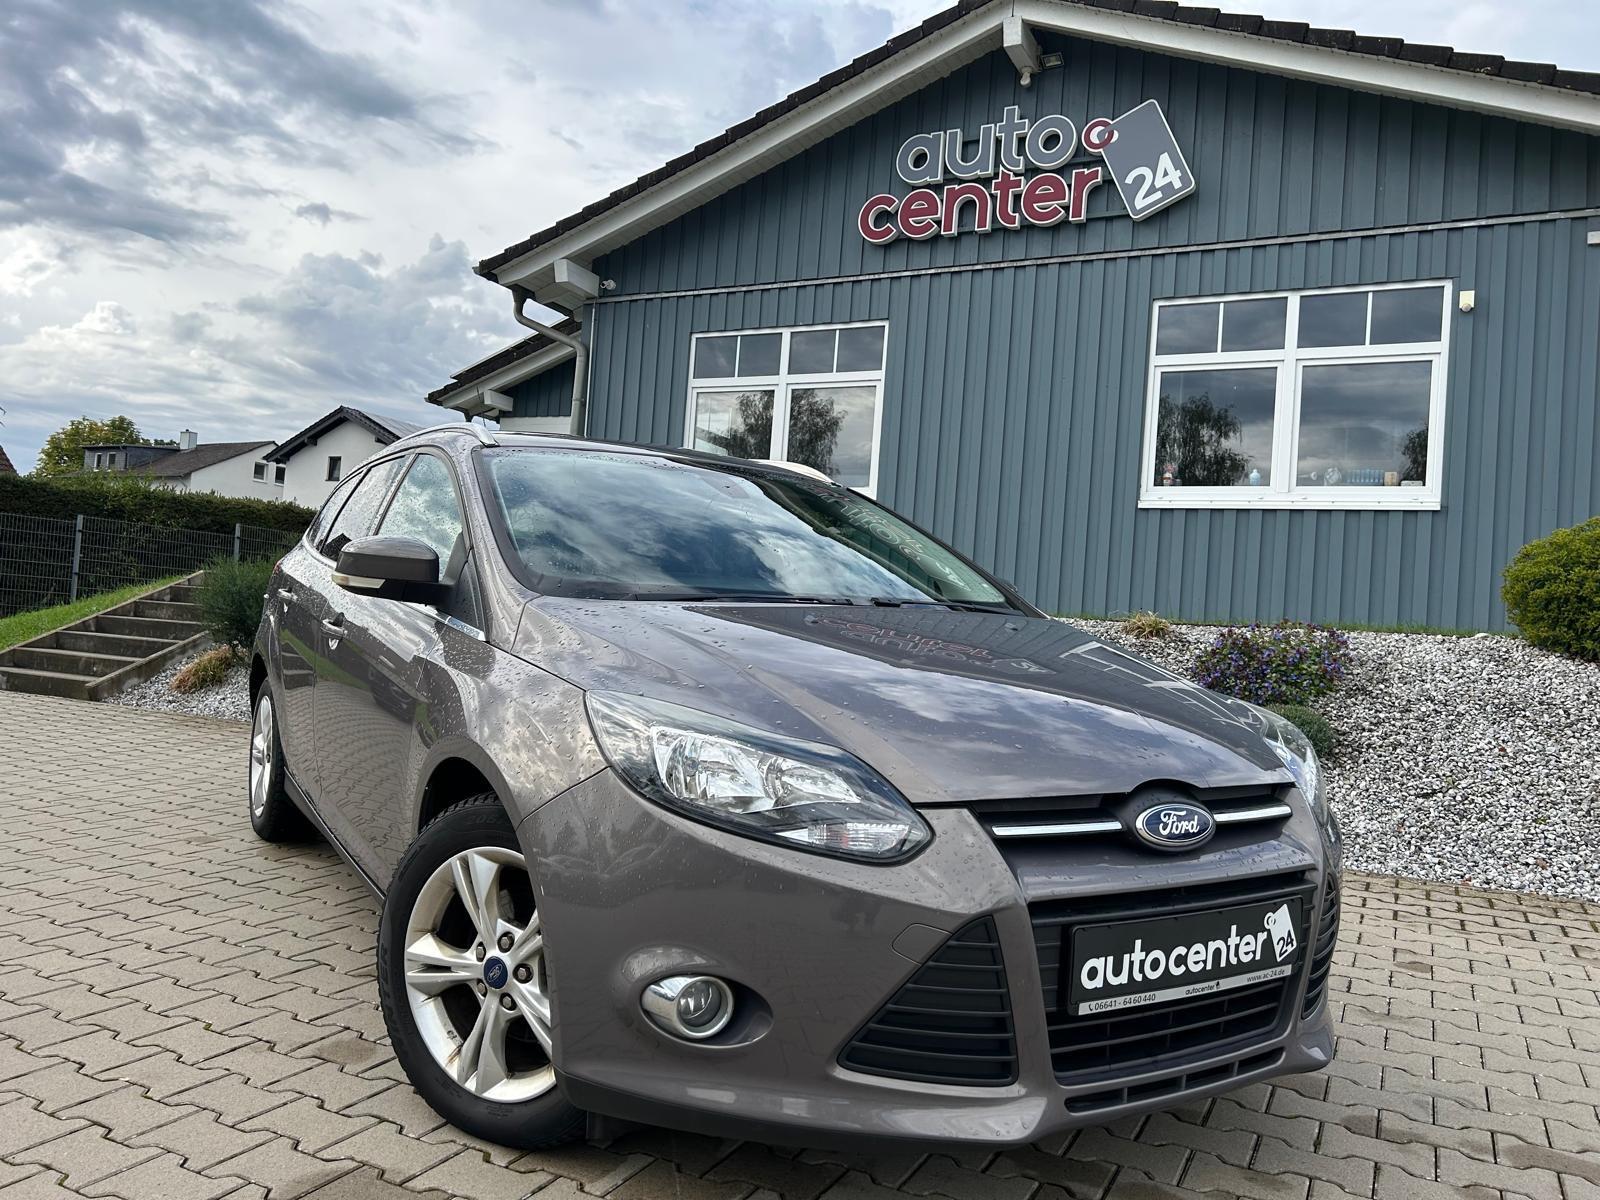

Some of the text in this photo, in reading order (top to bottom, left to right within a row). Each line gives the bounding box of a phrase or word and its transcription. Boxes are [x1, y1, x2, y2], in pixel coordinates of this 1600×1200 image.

[896, 105, 1078, 186] auto
[858, 165, 1102, 245] center
[1124, 151, 1182, 210] 24
[1159, 810, 1200, 835] Ford
[1080, 925, 1294, 990] autocenter 24
